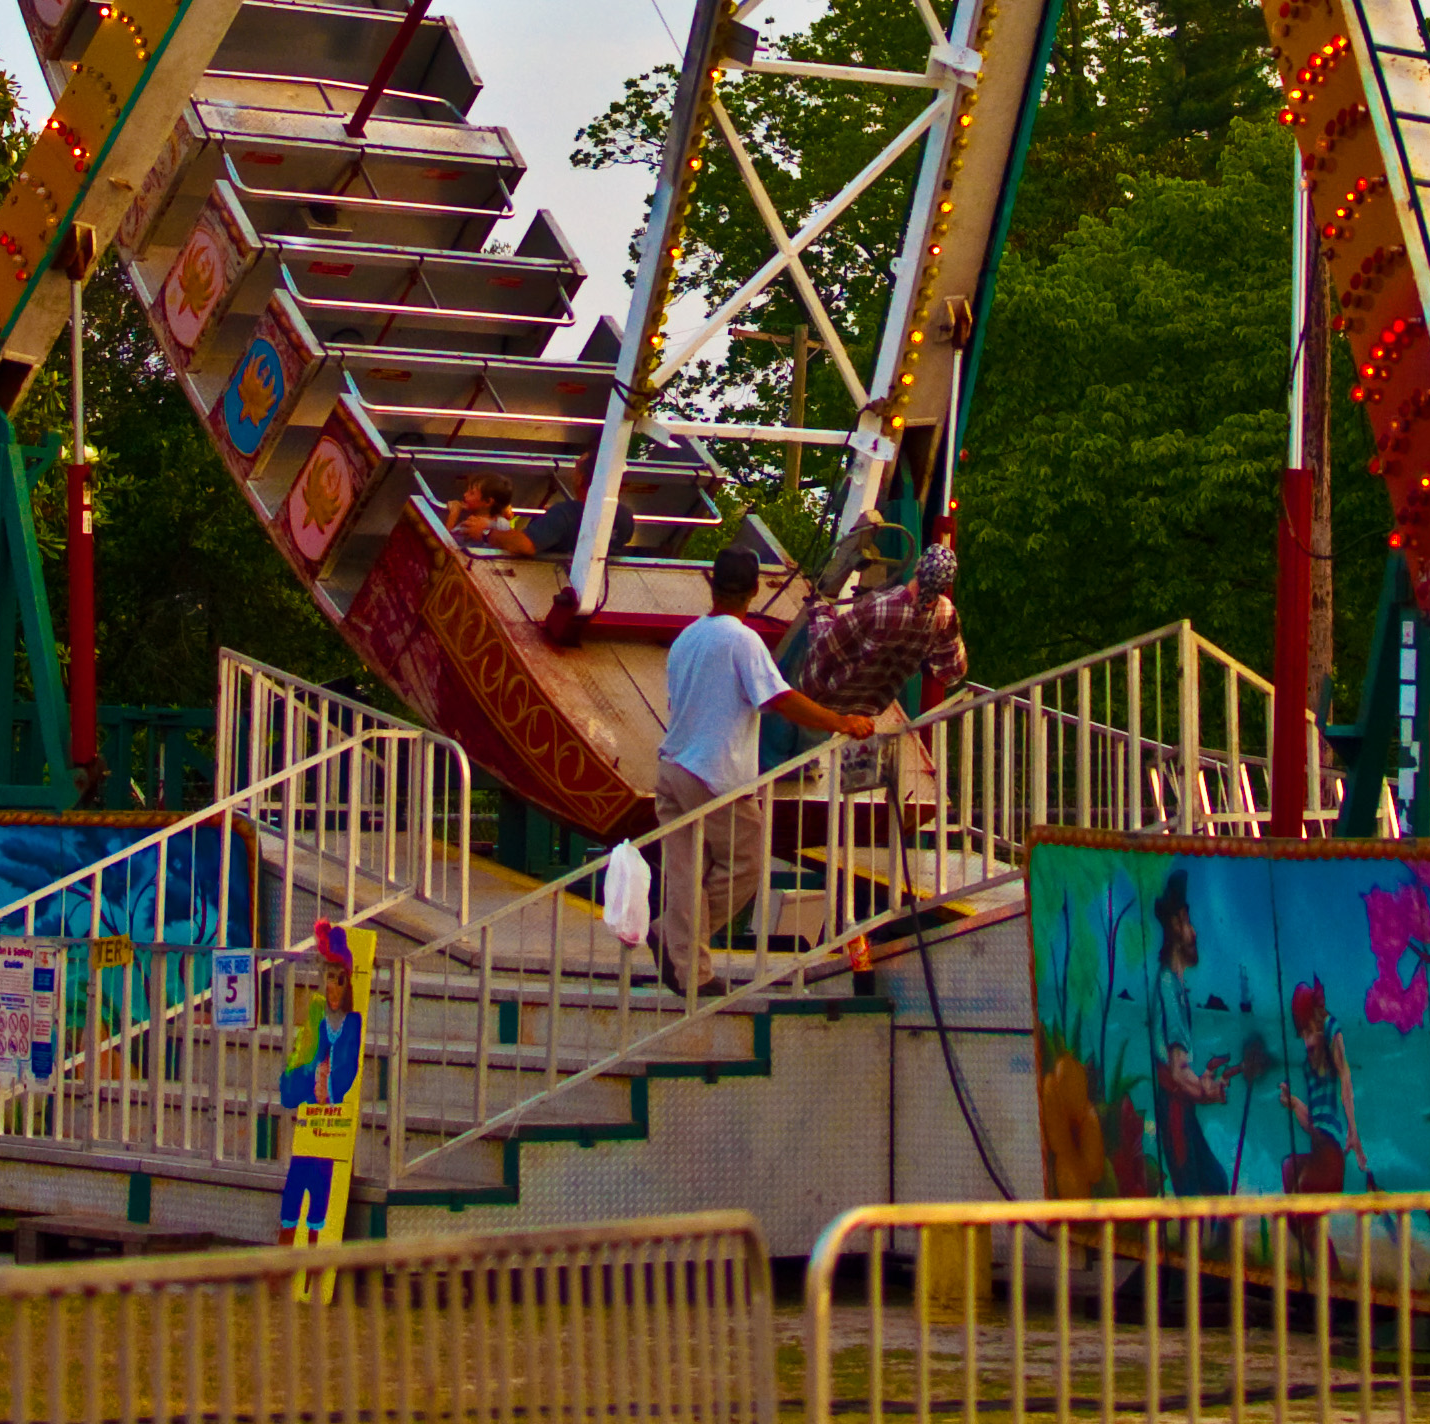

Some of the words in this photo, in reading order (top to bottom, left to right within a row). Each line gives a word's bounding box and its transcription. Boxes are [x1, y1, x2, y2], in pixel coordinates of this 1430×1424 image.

[218, 960, 232, 974] THIS
[234, 959, 249, 974] RIDE
[225, 975, 239, 1004] 5
